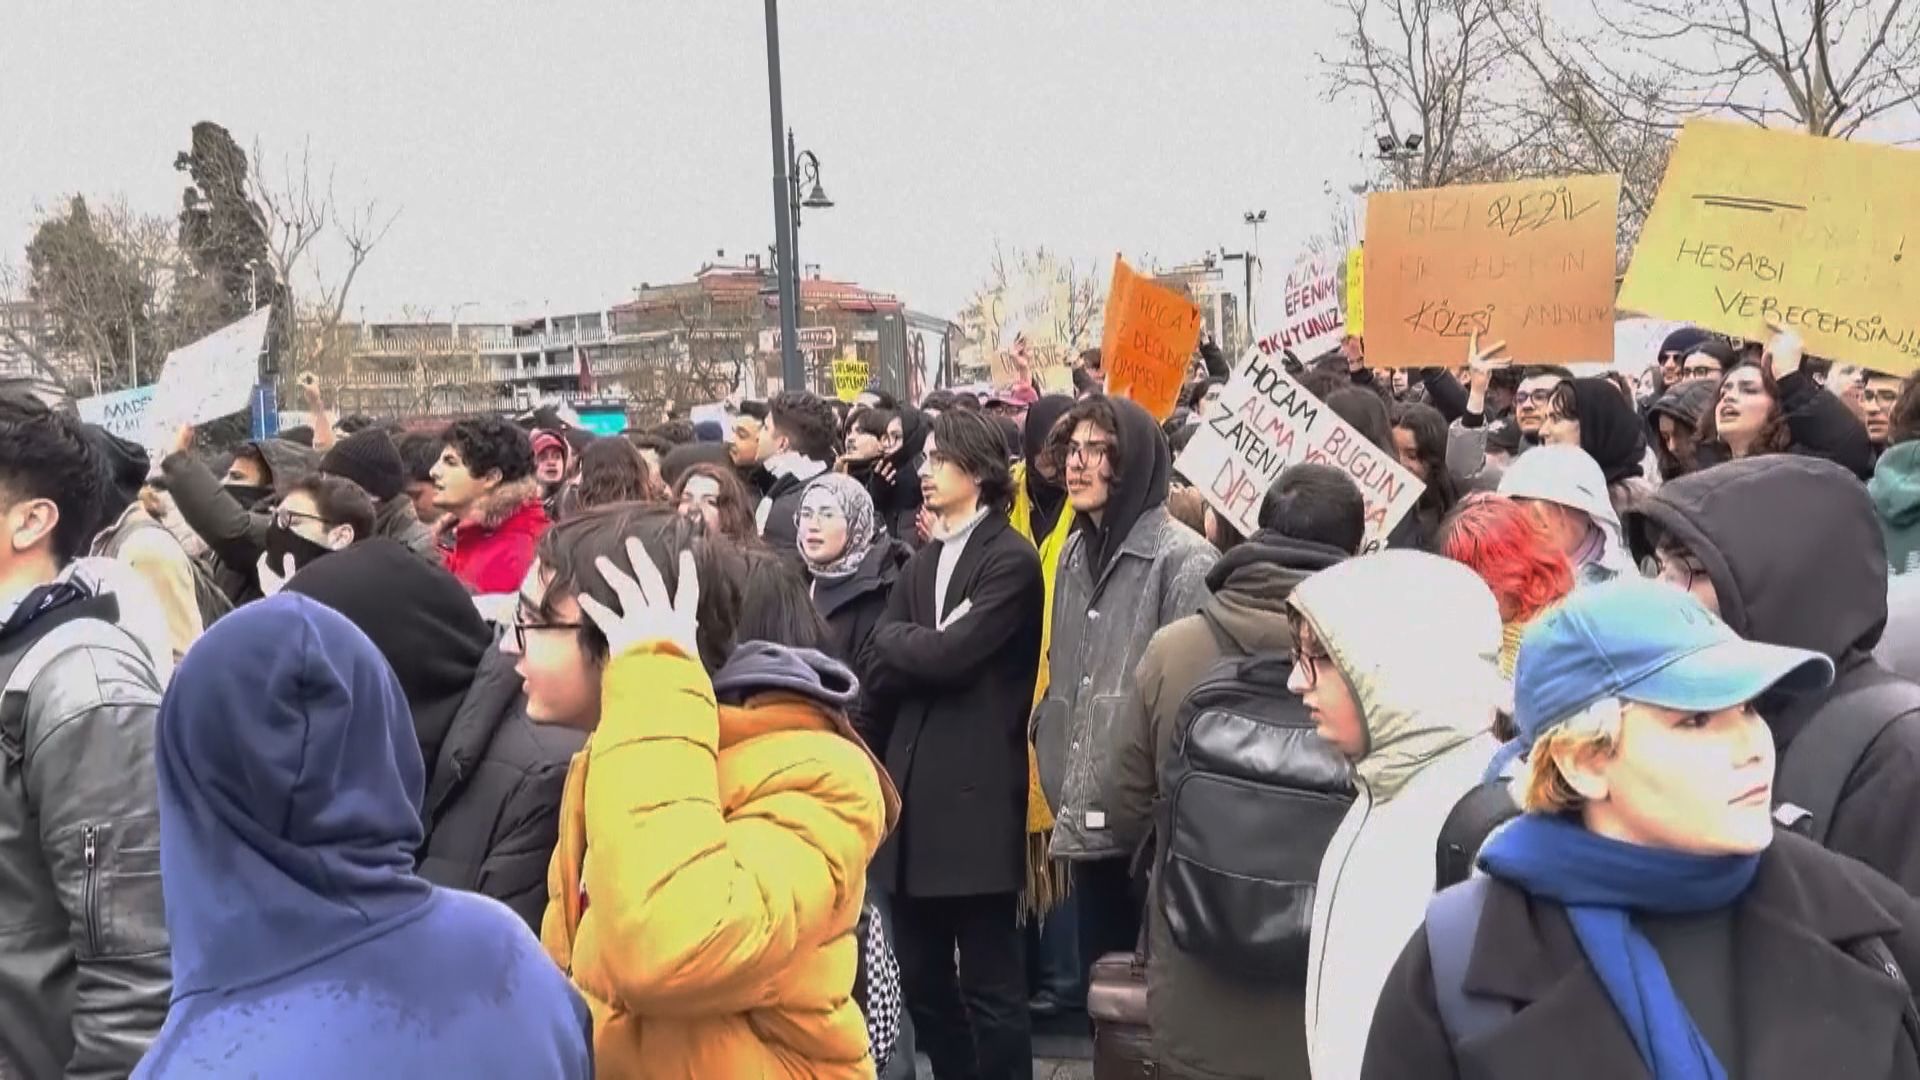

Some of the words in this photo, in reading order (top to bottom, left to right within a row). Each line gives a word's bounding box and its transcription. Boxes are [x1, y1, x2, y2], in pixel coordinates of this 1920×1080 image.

[1676, 238, 1785, 283] HESABI
[1238, 395, 1295, 457] ALMA
[1244, 354, 1318, 432] HOCAM
[1209, 402, 1278, 475] ZATEN
